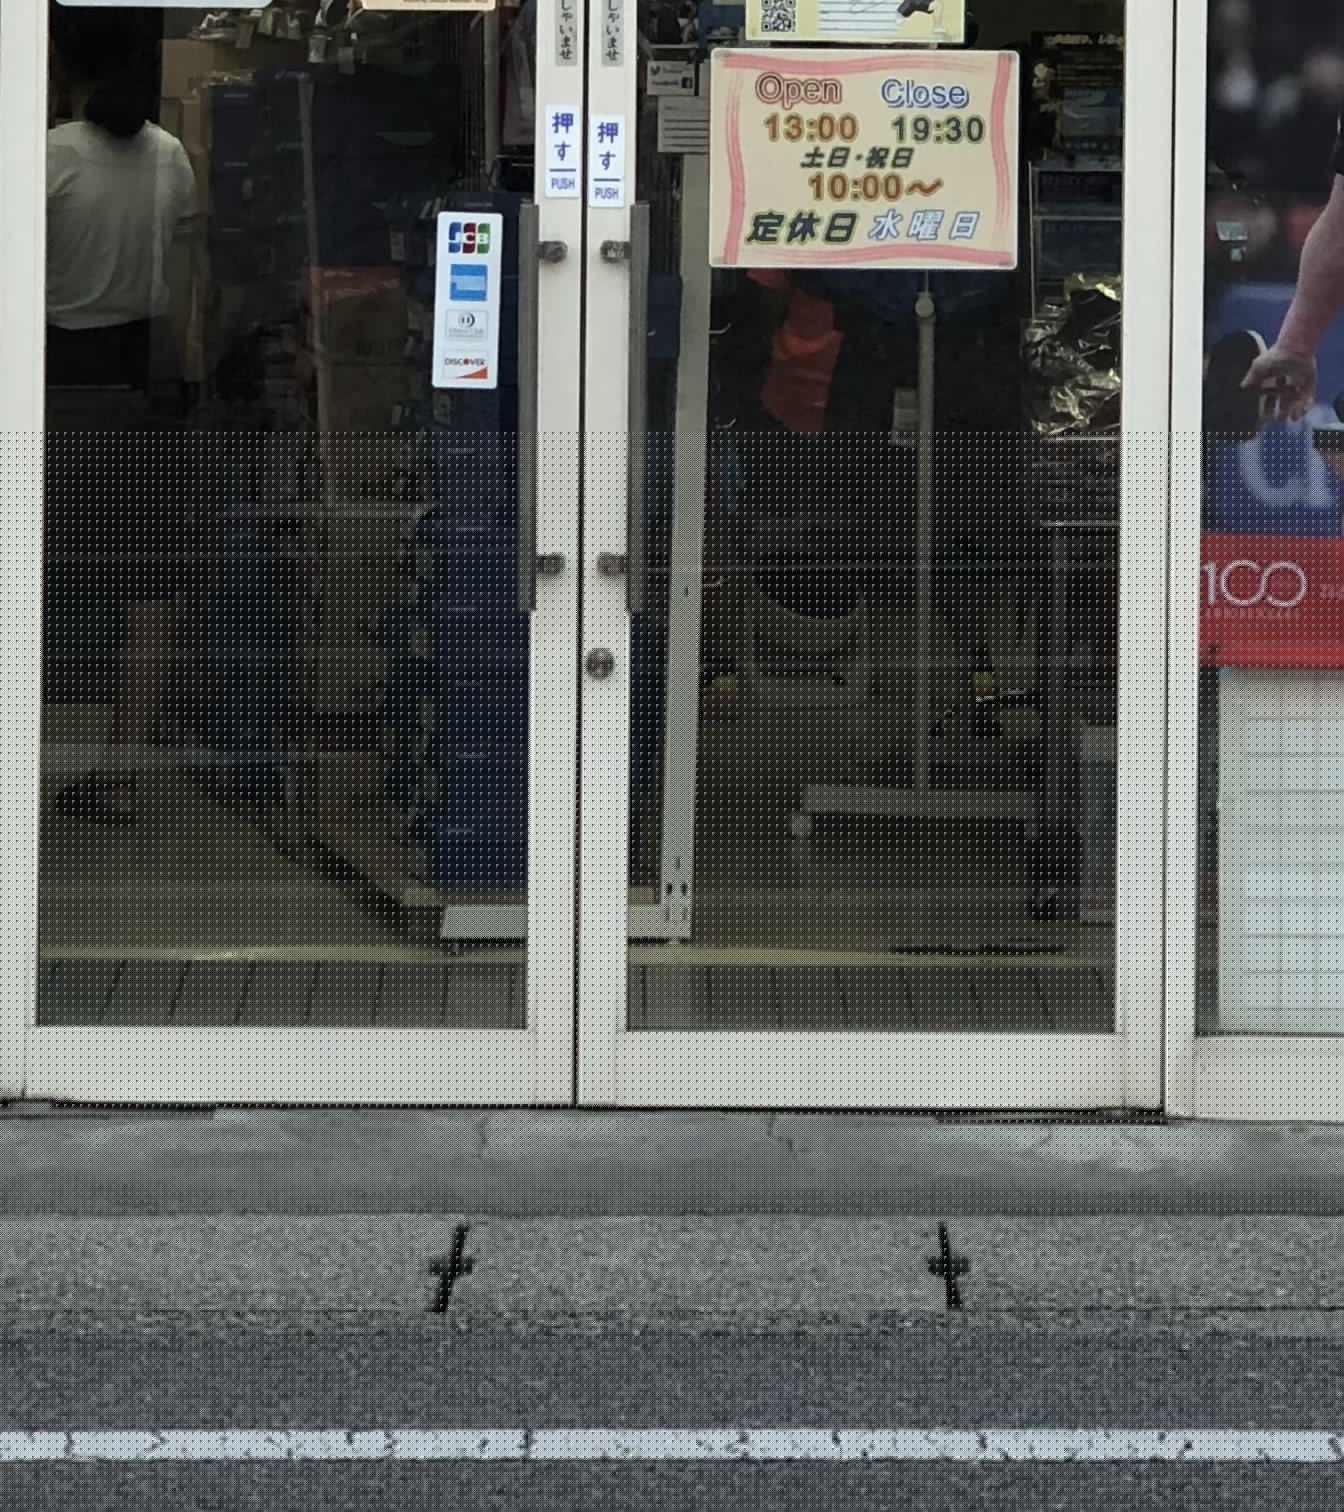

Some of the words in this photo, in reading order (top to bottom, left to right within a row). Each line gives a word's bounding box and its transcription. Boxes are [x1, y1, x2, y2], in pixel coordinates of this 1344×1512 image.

[755, 71, 842, 109] Open
[881, 78, 970, 109] Close
[552, 113, 573, 161] 押す
[764, 113, 858, 142] 13:00
[891, 115, 984, 143] 19:30
[598, 122, 619, 171] 押す
[801, 146, 914, 169] 土日・祝日
[551, 177, 575, 190] PUSH
[595, 187, 618, 200] PUSH
[449, 229, 490, 247] JCB
[747, 211, 856, 245] 定休日
[869, 210, 981, 241] 水曜日
